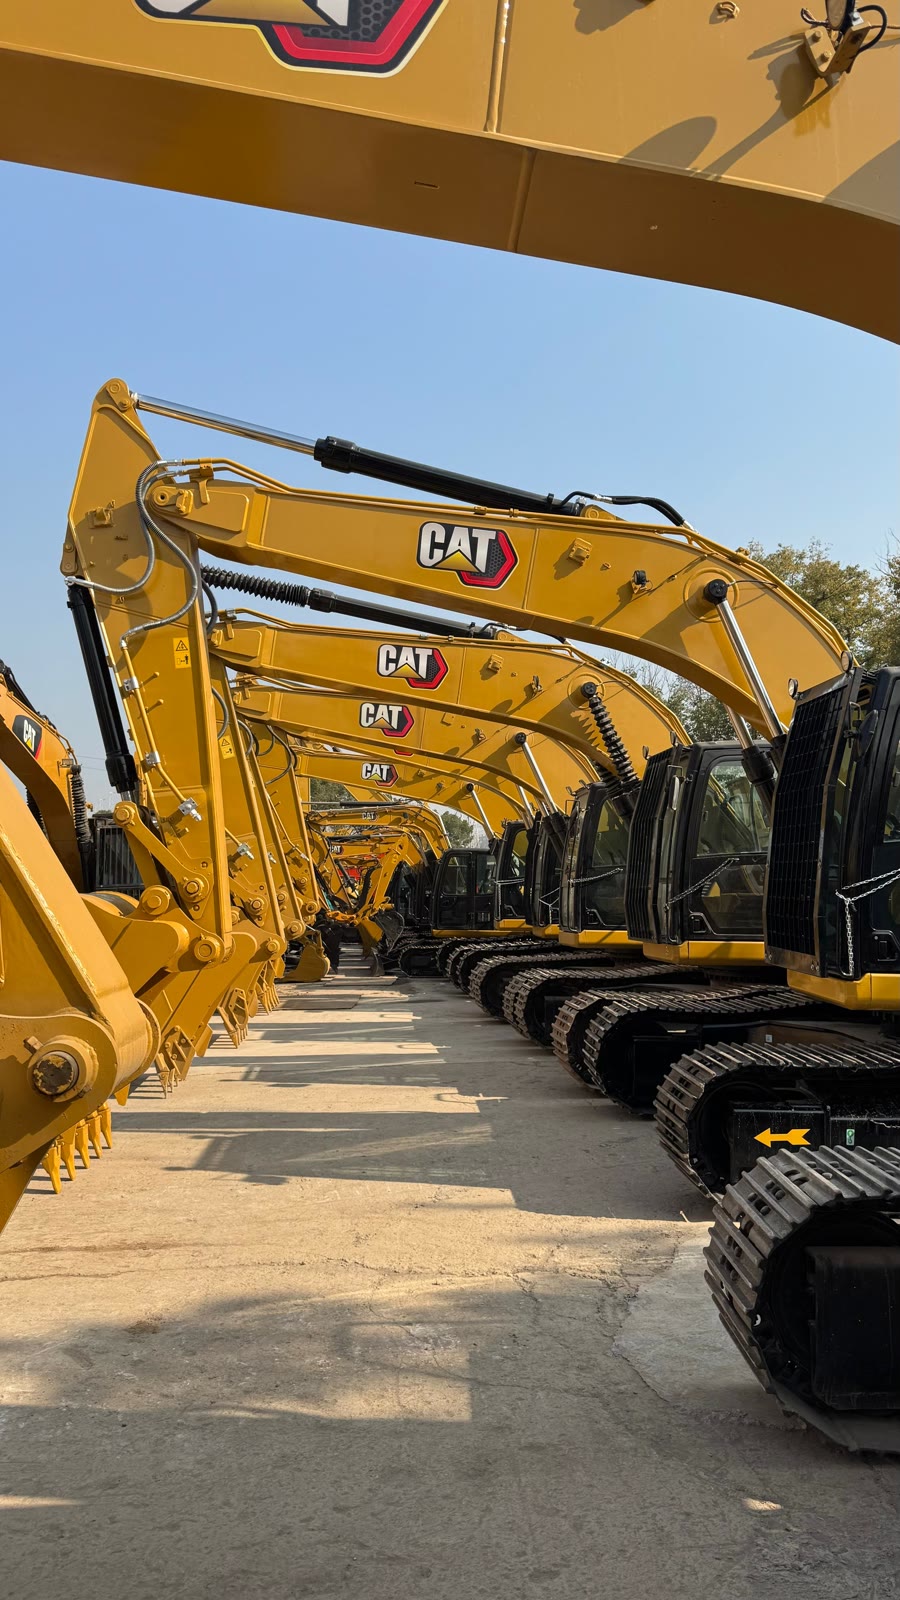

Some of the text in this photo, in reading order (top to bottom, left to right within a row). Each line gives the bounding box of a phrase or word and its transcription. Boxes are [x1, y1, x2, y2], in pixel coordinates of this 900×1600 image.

[419, 522, 496, 573] CAT
[378, 644, 433, 679] CAT
[360, 703, 403, 730] CAT
[23, 719, 36, 752] CAT
[361, 763, 389, 781] CAT
[362, 811, 375, 820] CAT
